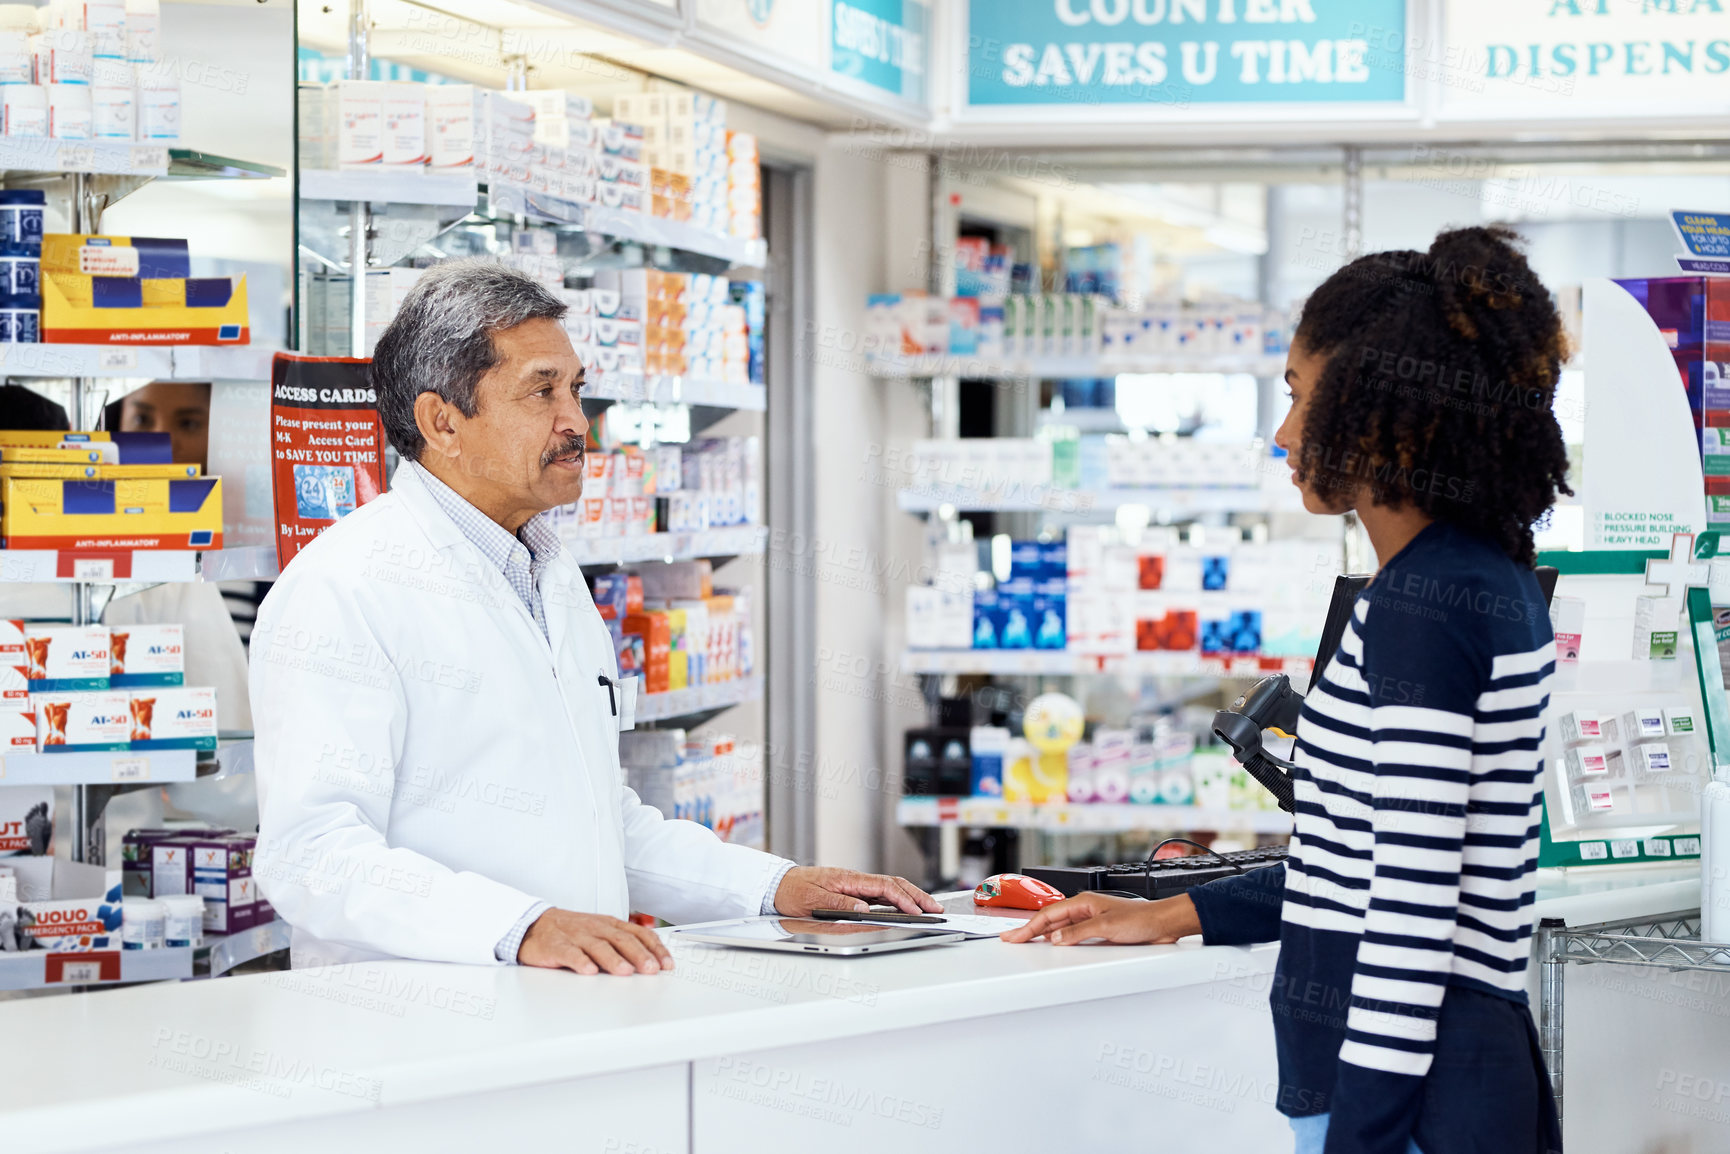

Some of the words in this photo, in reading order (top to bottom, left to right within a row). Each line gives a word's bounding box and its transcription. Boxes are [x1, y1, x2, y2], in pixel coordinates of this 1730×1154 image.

[1001, 41, 1168, 86] SAVES
[1179, 40, 1220, 85] U
[1230, 39, 1371, 84] TIME
[1485, 39, 1730, 79] DISPENS
[110, 332, 191, 341] ANTI-INFLAMMATORY
[275, 384, 318, 402] ACCESS
[320, 389, 378, 402] CARDS
[276, 415, 300, 428] Please
[302, 420, 342, 430] present
[345, 421, 374, 432] your
[308, 434, 343, 446] Access
[345, 435, 374, 446] Card
[276, 450, 284, 459] to
[286, 449, 314, 462] SAVE
[315, 450, 340, 462] YOU
[343, 451, 377, 463] TIME
[1604, 513, 1646, 522] BLOCKED
[1649, 513, 1674, 522] NOSE
[282, 524, 293, 537] By
[295, 524, 315, 536] Law
[1604, 524, 1646, 533] PRESSURE
[1650, 525, 1692, 534] BUILDING
[75, 539, 160, 548] ANTI-INFLAMMATORY
[1604, 536, 1632, 544] HEAVY
[1635, 536, 1660, 544] HEAD
[72, 650, 107, 660] AT-50
[149, 645, 181, 655] AT-50
[177, 709, 213, 719] AT-50
[92, 716, 128, 724] AT-50
[36, 908, 88, 924] UOUO
[24, 926, 76, 936] EMERGENCY
[76, 924, 98, 933] PACK
